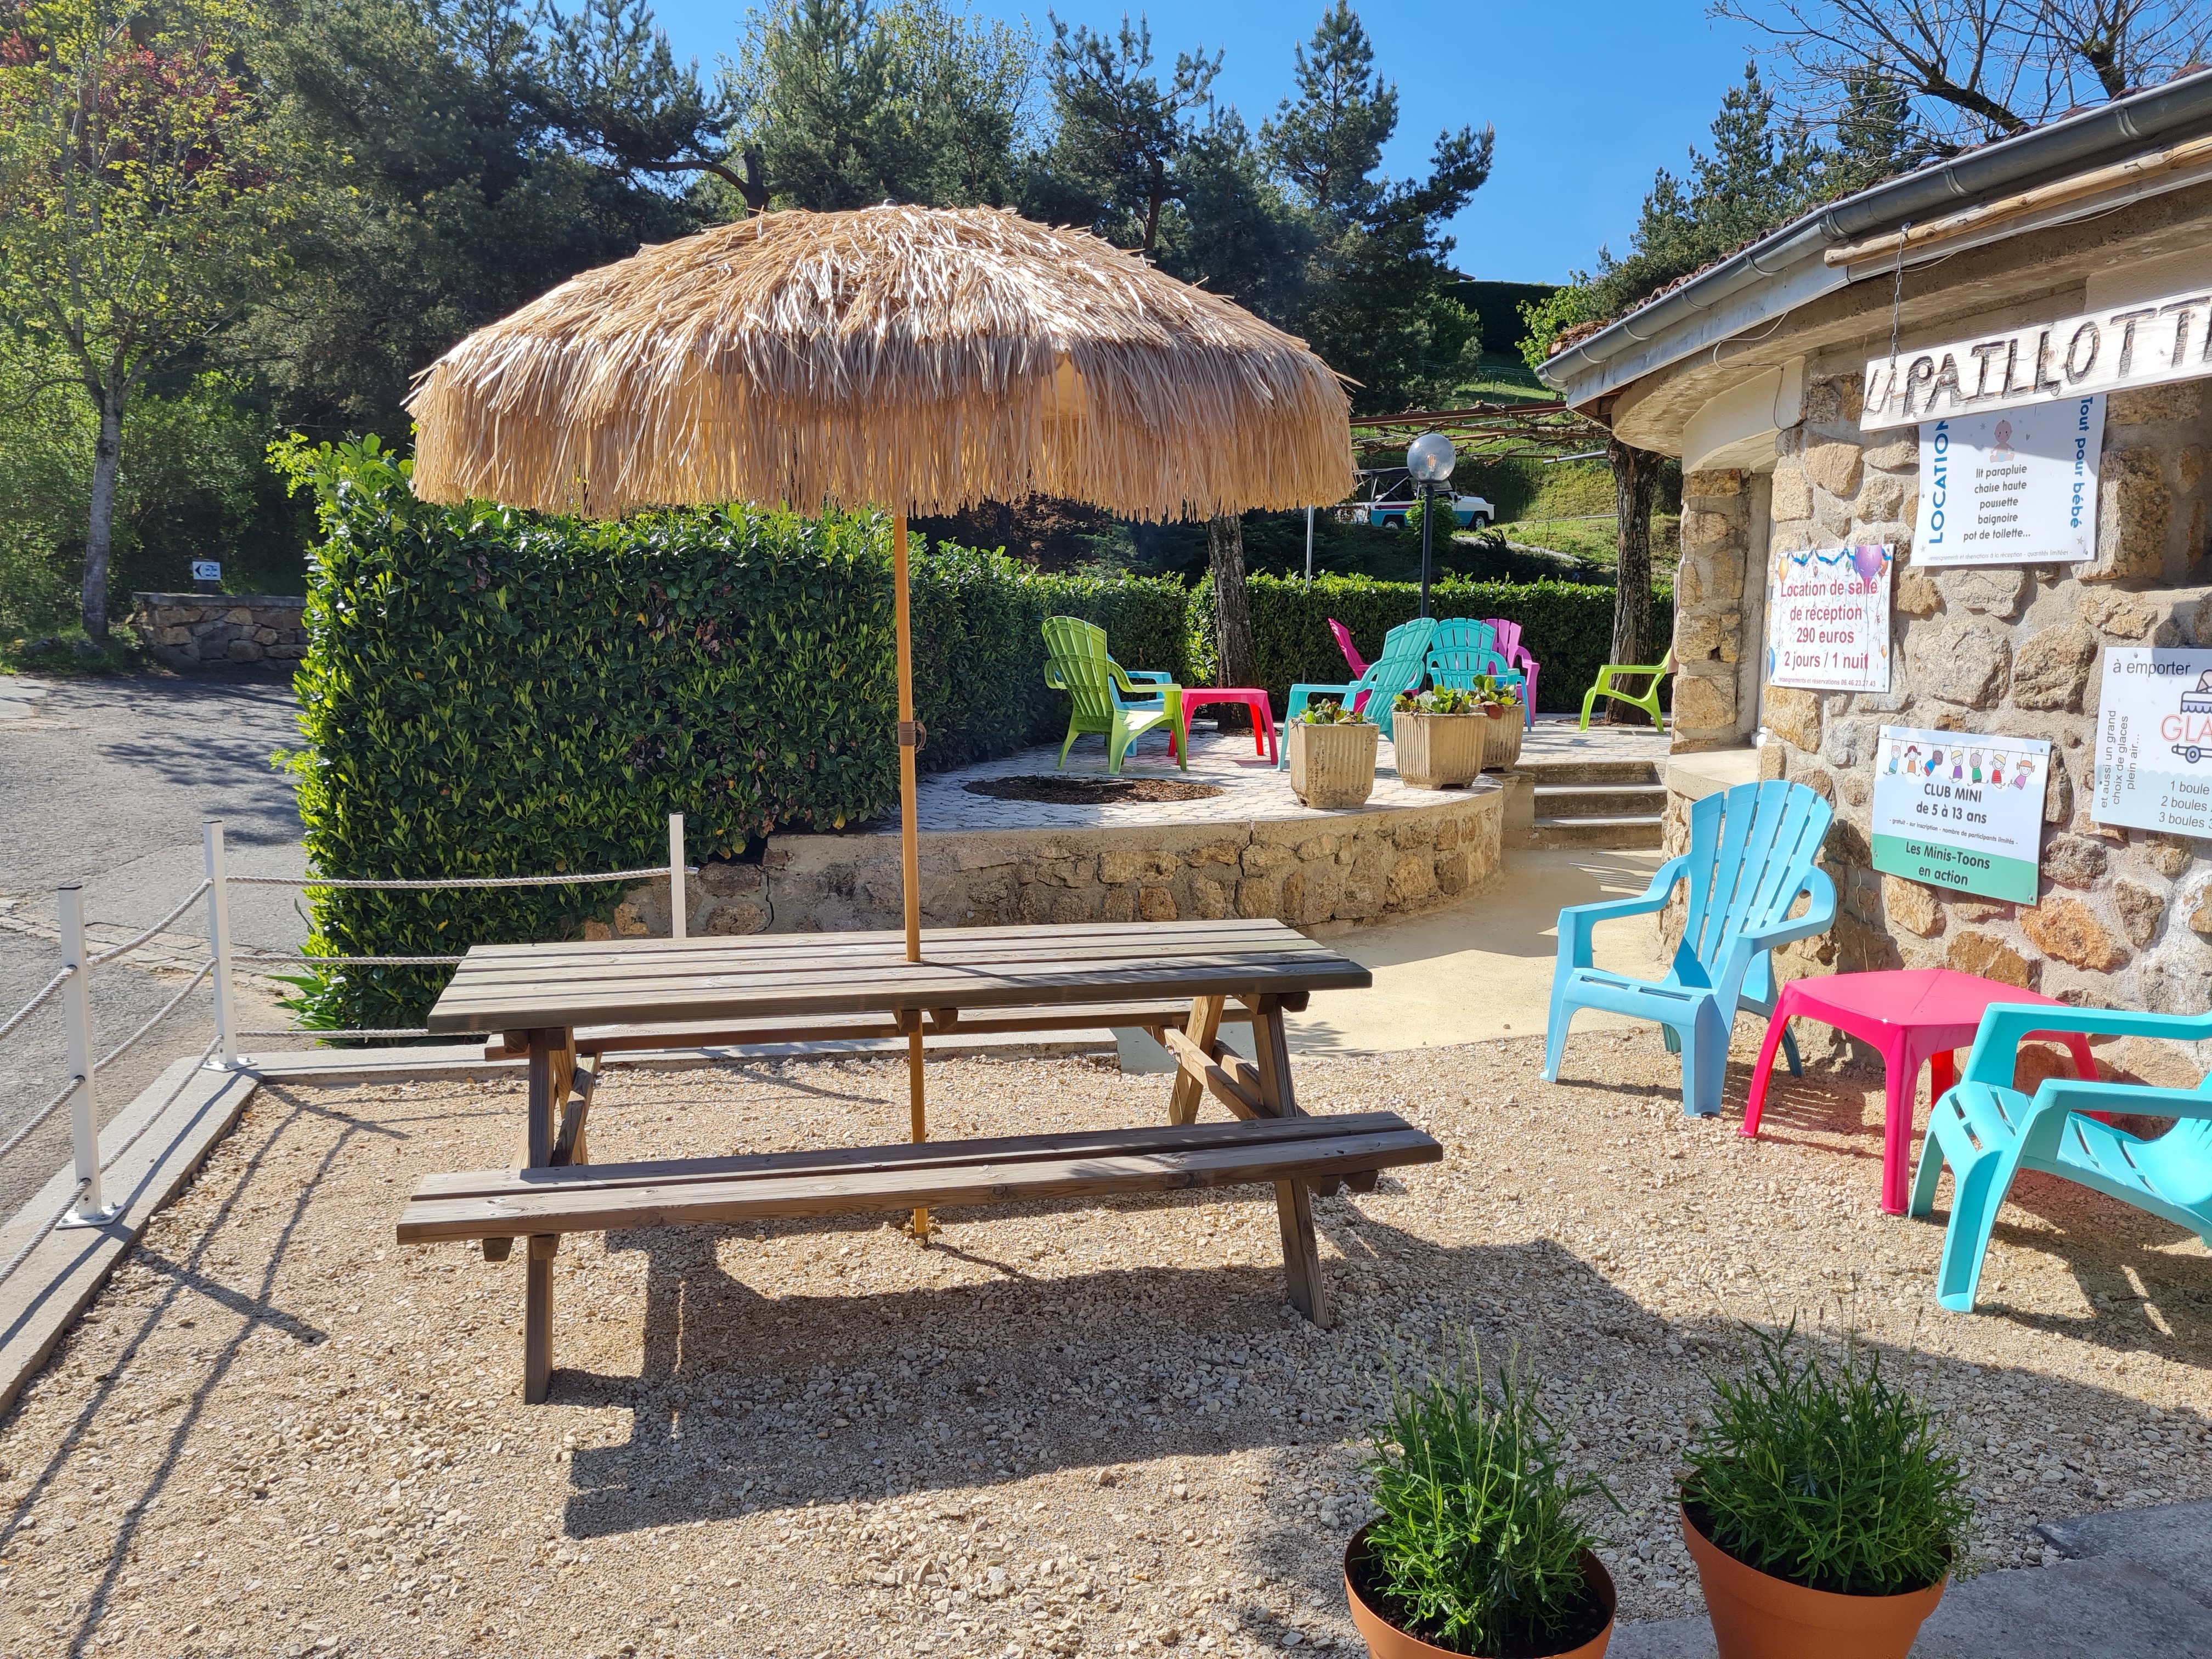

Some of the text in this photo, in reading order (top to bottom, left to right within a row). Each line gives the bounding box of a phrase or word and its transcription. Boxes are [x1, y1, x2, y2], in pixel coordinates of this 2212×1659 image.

[1902, 296, 2212, 418] PAILLOTT
[1976, 464, 2027, 480] lit parapluie
[2070, 397, 2094, 528] Tout pour bébé
[1974, 480, 2027, 494] chaise haute
[1979, 496, 2019, 511] poussette
[1978, 512, 2018, 526] baignoire
[1963, 528, 2031, 543] pot de toilette...
[1781, 577, 1877, 597] Location de salle
[1790, 604, 1862, 625] de réception
[1796, 627, 1854, 644] 290 euros
[1784, 651, 1790, 667] 2
[1792, 651, 1820, 671] jours
[1832, 652, 1838, 668] 1
[1843, 652, 1869, 670] nuit
[2113, 659, 2191, 678] à emporter
[2101, 710, 2116, 808] et aussi un grand
[2112, 716, 2129, 805] choix de glaces
[2126, 733, 2140, 790] plein air...
[1924, 783, 1982, 803] CLUB MINI
[2170, 780, 2210, 795] 1 boule
[1916, 800, 1987, 824] de 5 à 13 ans
[2160, 795, 2208, 811] 2 boules
[2158, 811, 2165, 822] 3
[2168, 812, 2205, 828] boules
[1916, 822, 1938, 831] inscription
[1968, 833, 1997, 842] participants
[1997, 837, 2015, 845] limités
[1905, 841, 1990, 870] Les Minis-Toons
[1918, 866, 1968, 886] en action
